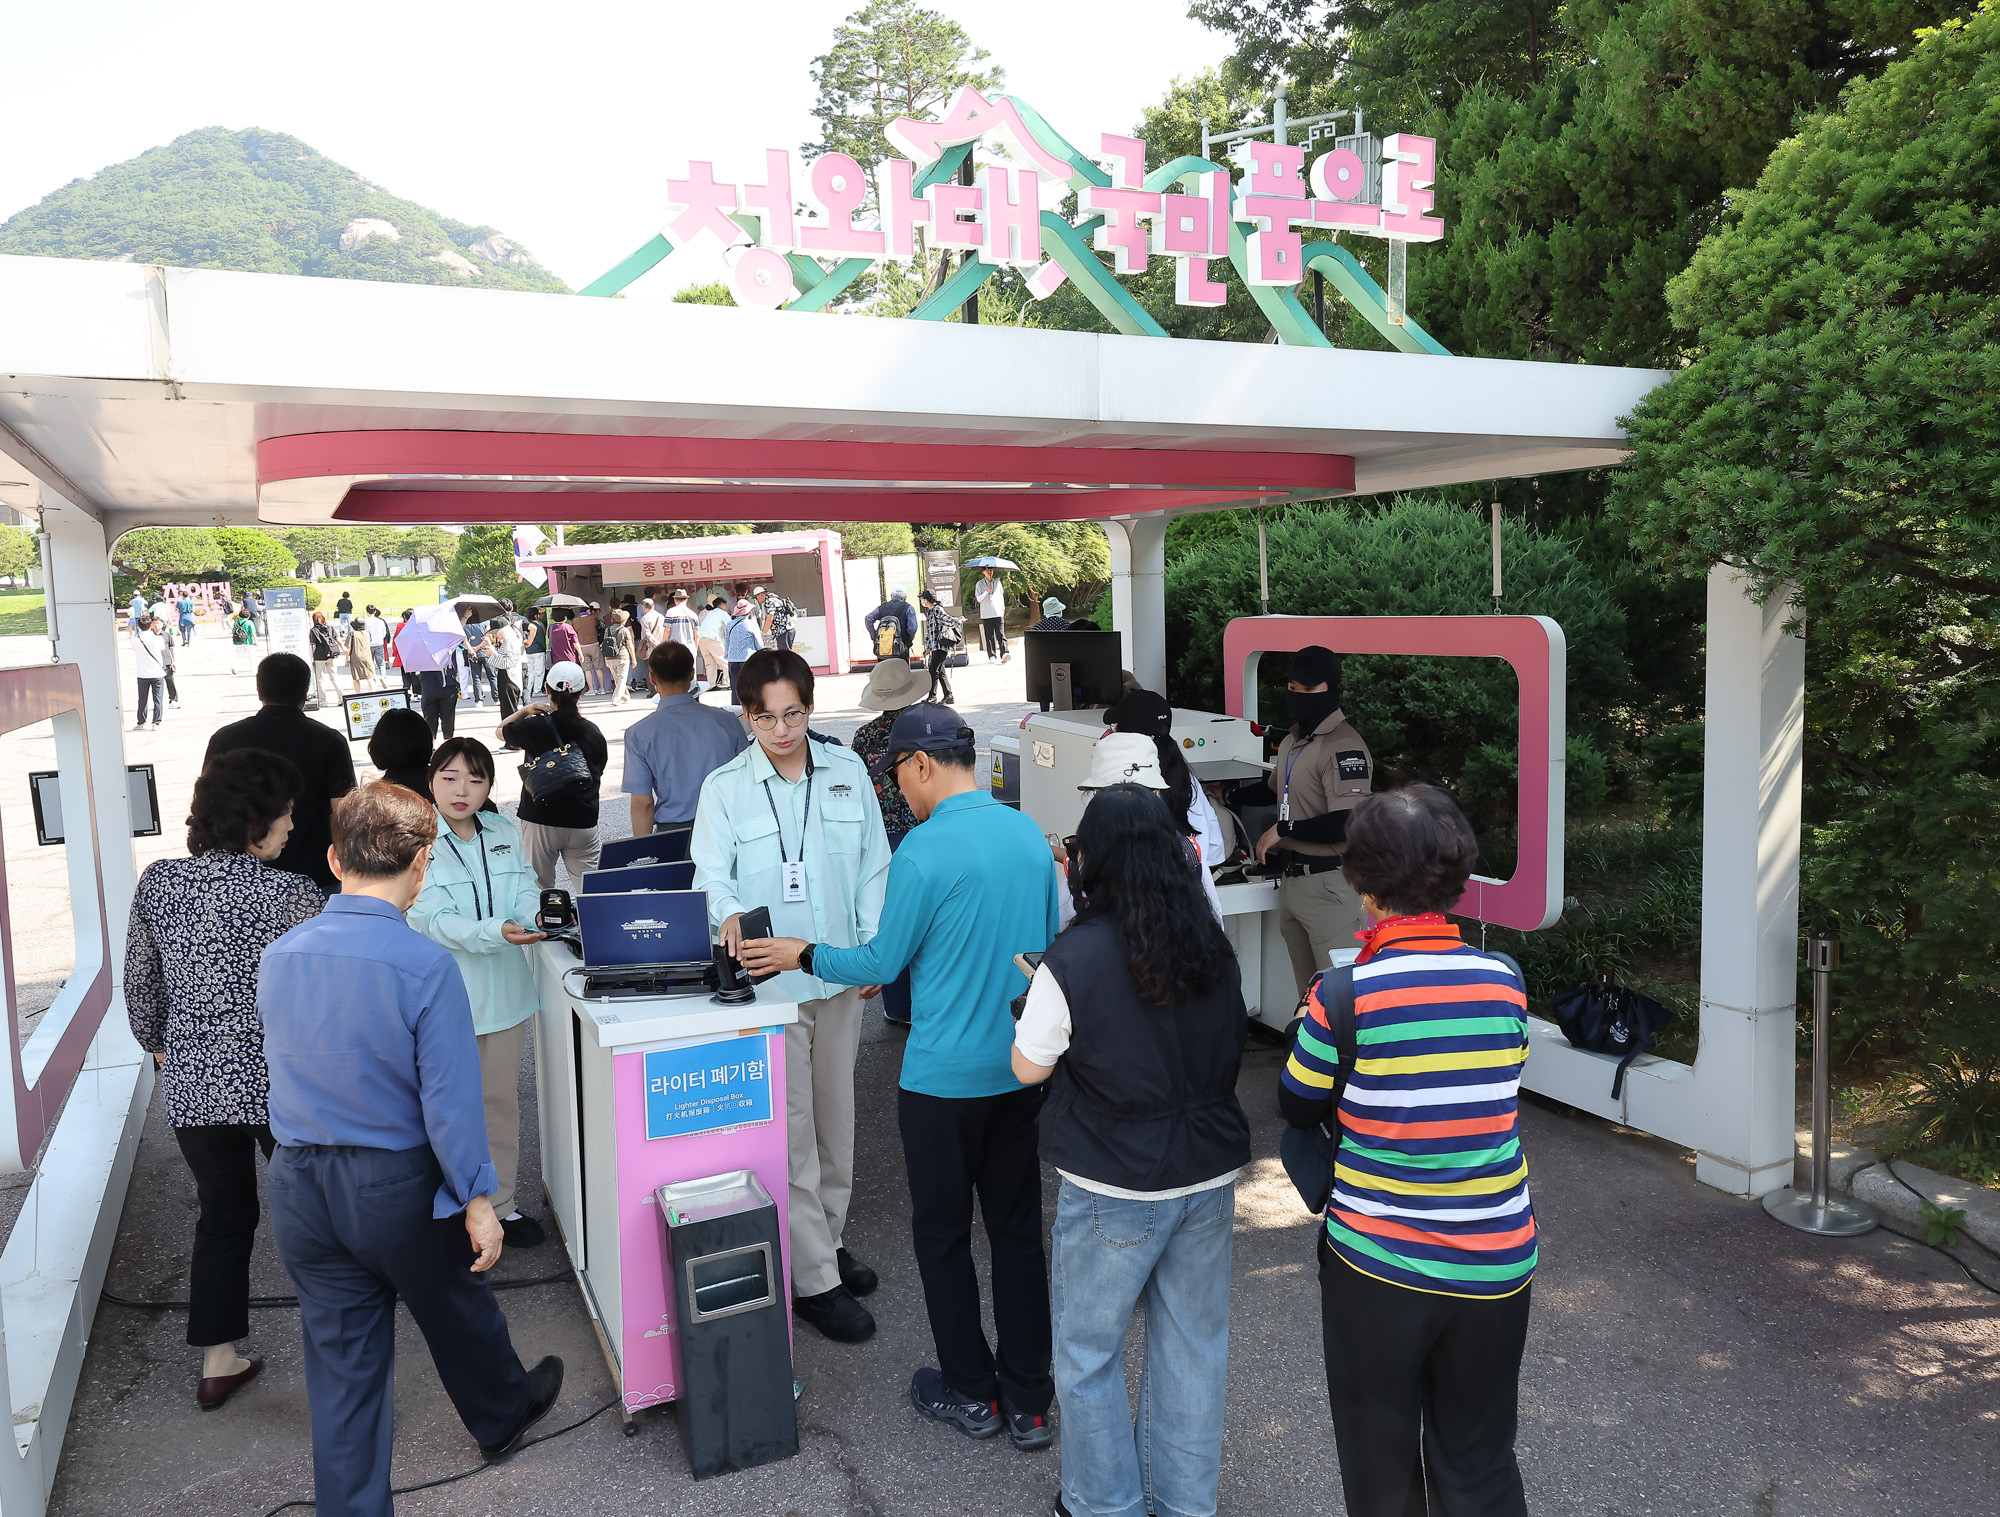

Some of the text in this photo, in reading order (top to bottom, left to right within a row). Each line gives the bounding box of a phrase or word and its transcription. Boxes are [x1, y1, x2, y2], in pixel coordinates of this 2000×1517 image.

[642, 558, 733, 578] 종합안내소
[650, 1059, 766, 1096] 라이터 폐기함
[674, 1092, 744, 1111] Lighter Disposal Box
